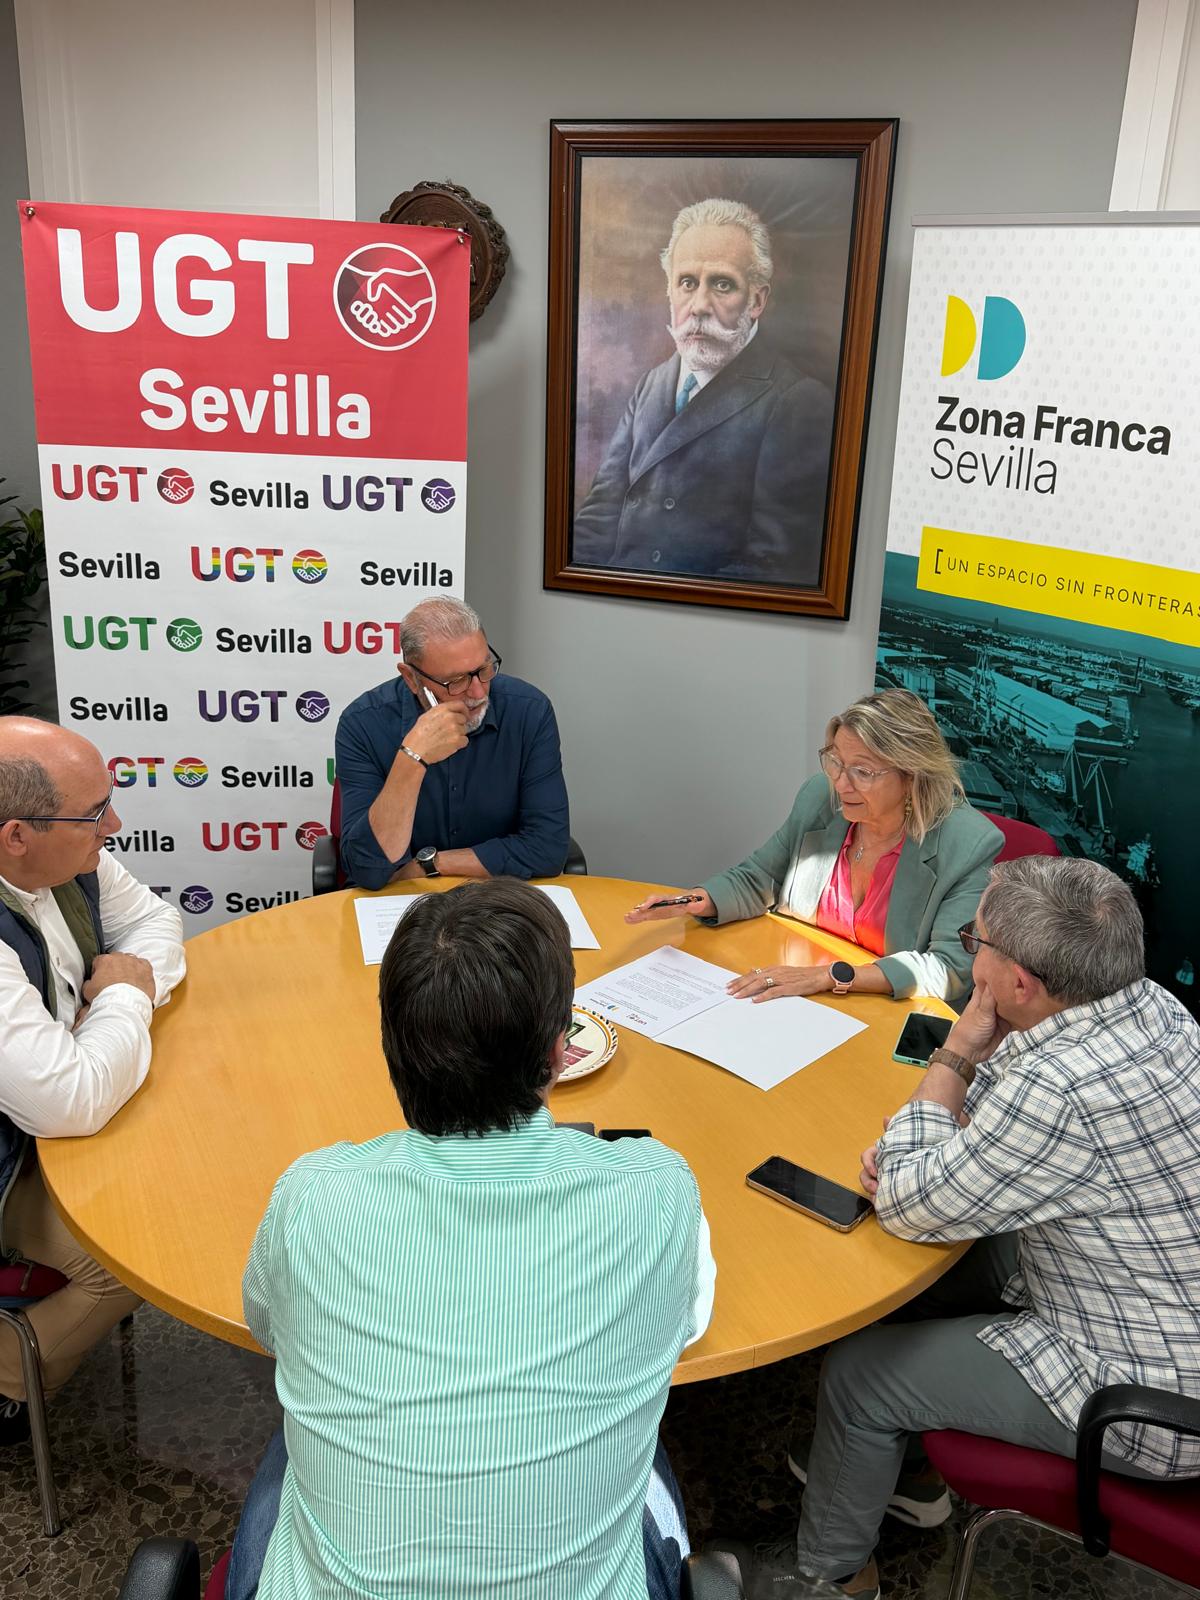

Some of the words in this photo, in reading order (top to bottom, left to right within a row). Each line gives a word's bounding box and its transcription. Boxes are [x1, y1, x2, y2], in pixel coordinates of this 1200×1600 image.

[57, 228, 314, 340] UGT
[139, 368, 371, 440] Sevilla
[935, 396, 1025, 439] Zona
[1033, 405, 1172, 456] Franca
[51, 463, 147, 503] UGT
[209, 481, 309, 509] Sevilla
[322, 474, 413, 513] UGT
[930, 437, 1058, 495] Sevilla
[58, 551, 160, 580] Sevilla
[190, 546, 283, 583] UGT
[360, 562, 453, 587] Sevilla
[977, 562, 1047, 588] ESPACIO
[1056, 577, 1085, 595] SIN
[1093, 584, 1200, 618] FRONTERA
[63, 615, 157, 651] UGT
[216, 628, 312, 653] Sevilla
[323, 621, 401, 655] UGT
[70, 696, 168, 721] Sevilla
[198, 690, 287, 723] UGT
[107, 757, 165, 788] GT
[221, 765, 314, 788] Sevilla
[104, 830, 175, 853] evilla
[202, 822, 288, 851] UGT
[225, 891, 312, 913] Sevil
